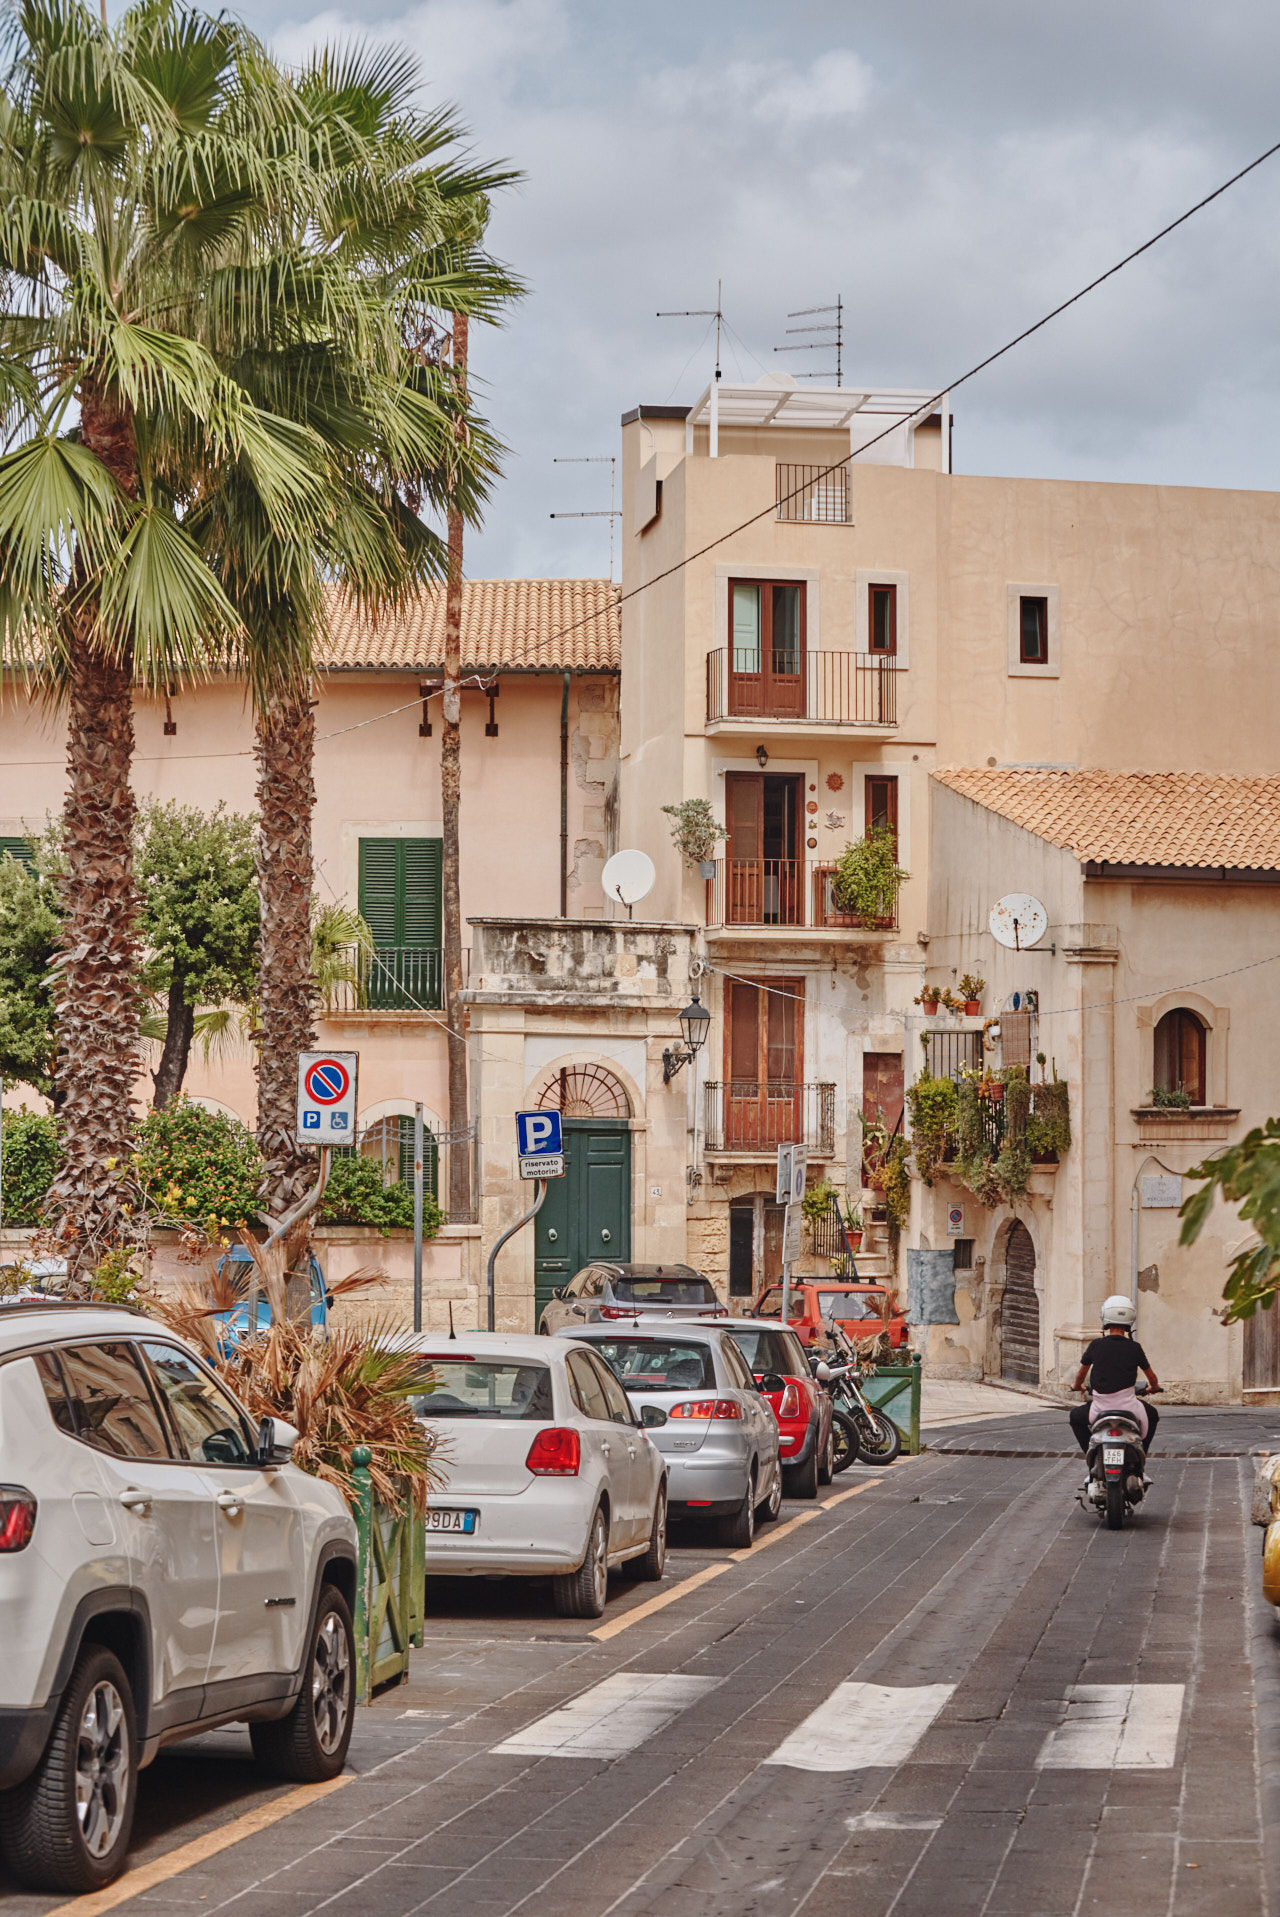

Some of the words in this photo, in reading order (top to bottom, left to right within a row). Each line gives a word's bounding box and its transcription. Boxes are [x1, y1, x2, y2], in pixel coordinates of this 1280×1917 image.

[306, 1112, 318, 1127] P
[525, 1115, 553, 1152] P
[525, 1159, 559, 1168] riservato
[526, 1167, 559, 1177] motorini
